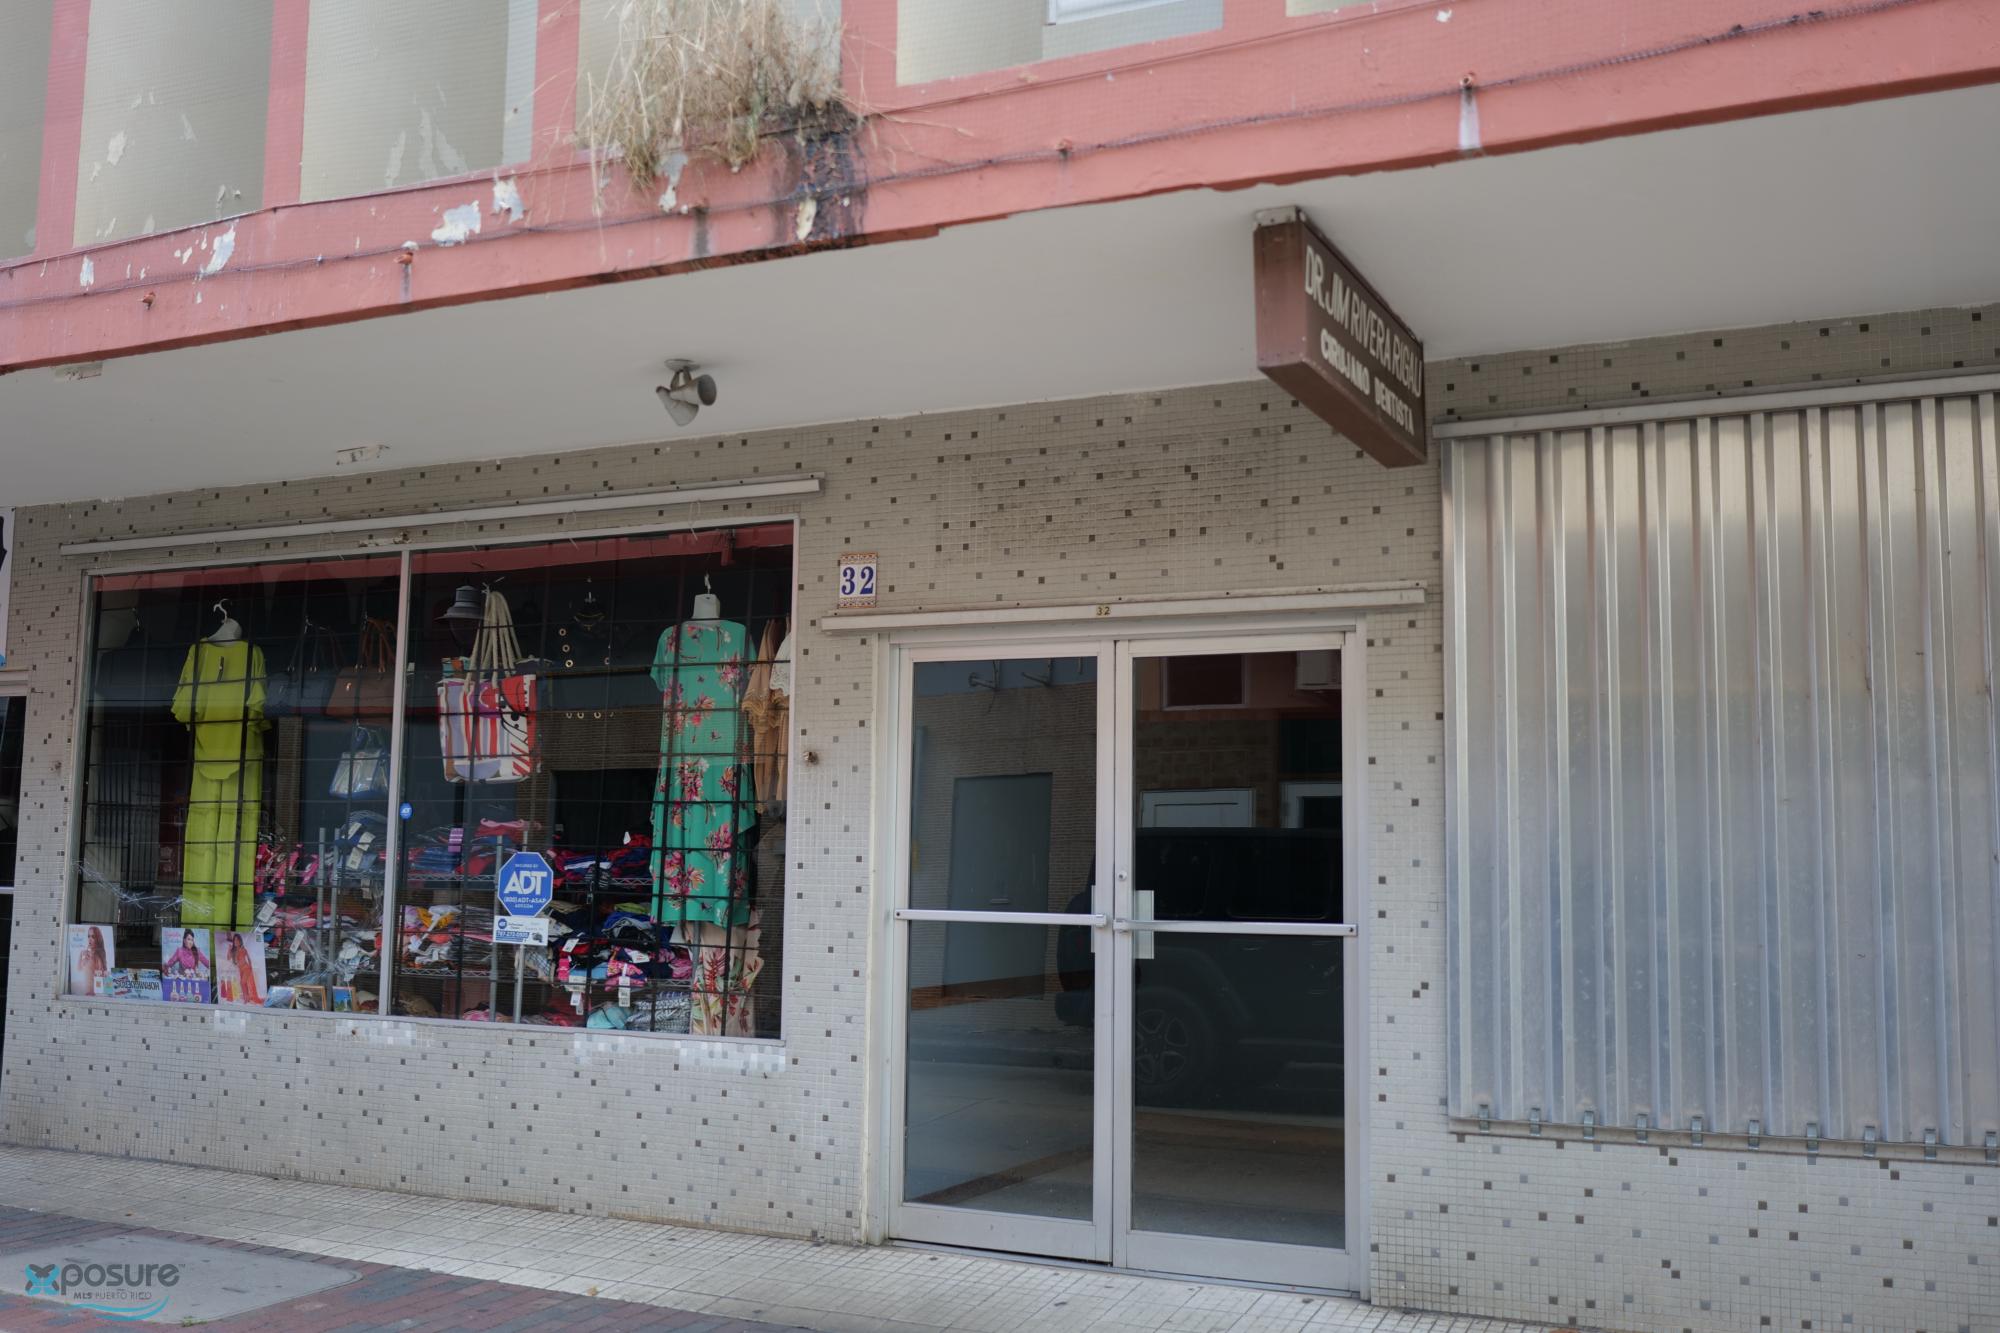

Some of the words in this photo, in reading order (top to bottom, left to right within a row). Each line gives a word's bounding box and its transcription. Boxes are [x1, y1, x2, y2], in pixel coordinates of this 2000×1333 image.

[1350, 291, 1391, 371] RIVERA
[1392, 333, 1423, 398] RIGAU
[1320, 328, 1370, 396] CIRUJANO
[1374, 376, 1415, 436] DENTISTA
[841, 566, 874, 595] 32
[1096, 606, 1111, 616] 32
[503, 870, 548, 896] ADT
